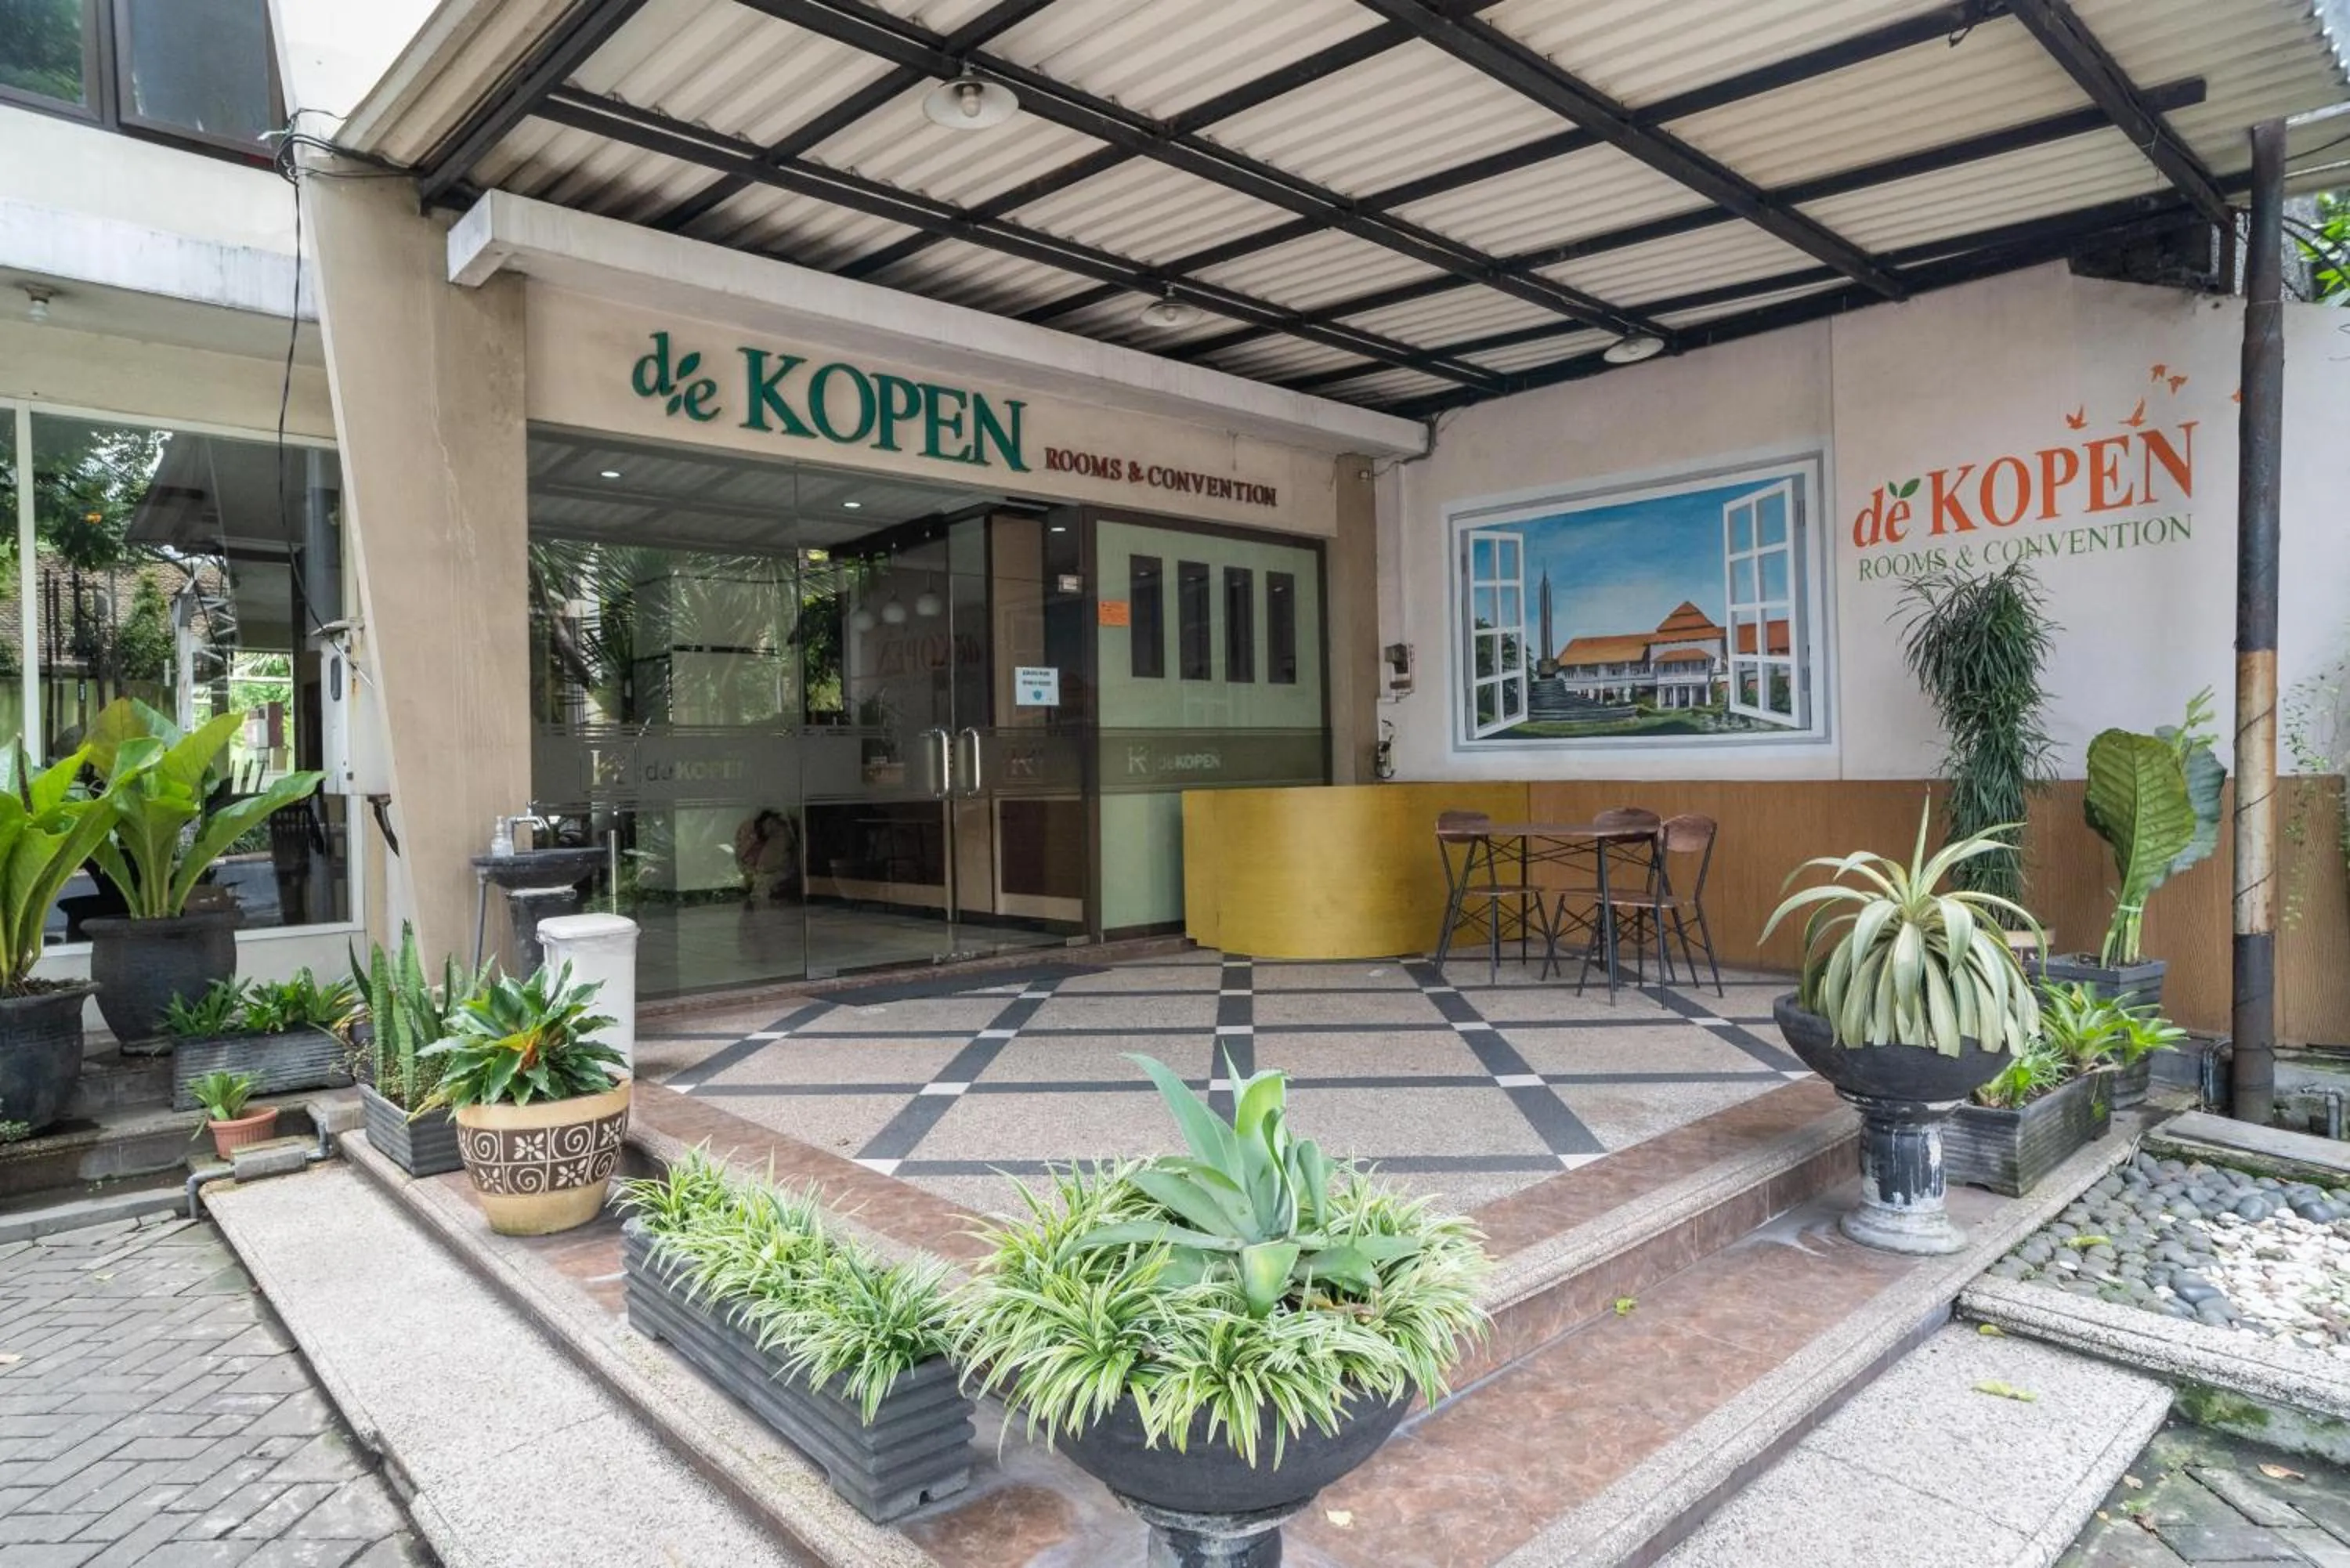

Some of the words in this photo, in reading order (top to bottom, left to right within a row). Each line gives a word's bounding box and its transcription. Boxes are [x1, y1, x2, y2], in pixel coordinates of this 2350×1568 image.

[632, 331, 721, 421] de
[737, 347, 1032, 472] KOPEN
[1045, 446, 1123, 481] ROOMS
[1127, 461, 1144, 483] &
[1148, 465, 1277, 508] CONVENTION
[1853, 486, 1911, 549] de
[1925, 421, 2200, 537] KOPEN
[1858, 547, 1947, 581] ROOMS
[1955, 546, 1976, 571] &
[1983, 513, 2193, 565] CONVENTION
